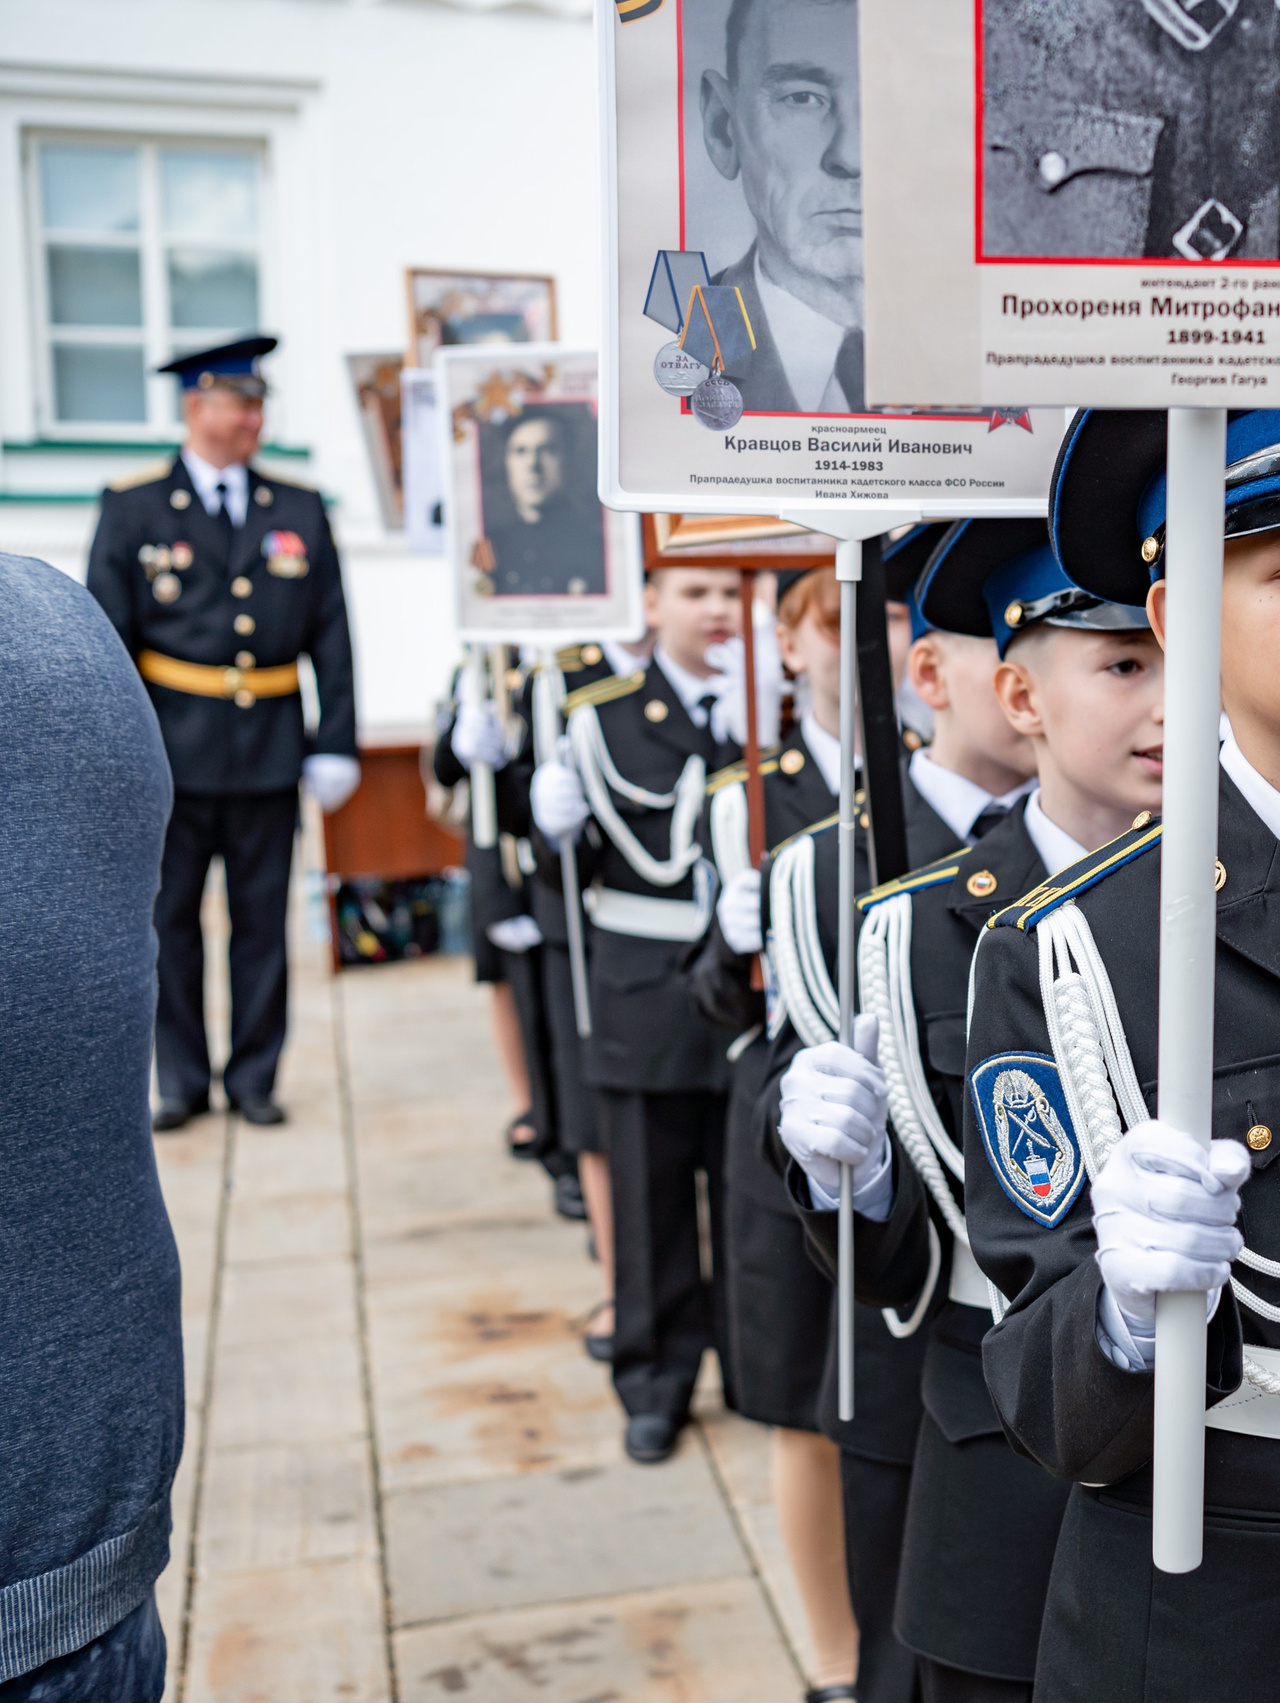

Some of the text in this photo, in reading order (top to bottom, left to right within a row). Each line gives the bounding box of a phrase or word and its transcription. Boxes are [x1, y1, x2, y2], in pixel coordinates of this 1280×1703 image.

[1220, 277, 1249, 289] 2-го
[1002, 294, 1141, 320] Прохореня
[1151, 296, 1280, 321] Митрофан
[1168, 330, 1265, 344] 1899-1941
[986, 352, 1105, 368] Прапрадедушка
[1110, 355, 1213, 365] воспитанника
[1171, 373, 1227, 386] Георгия
[811, 425, 887, 435] красноармеец
[725, 435, 972, 454] Кравцов Василий Иванович
[815, 460, 884, 471] 1914-1983
[689, 474, 1005, 488] Прапрадедушка воспитанника кадетского класса ФСО России
[815, 490, 889, 499] Ивана Хижова
